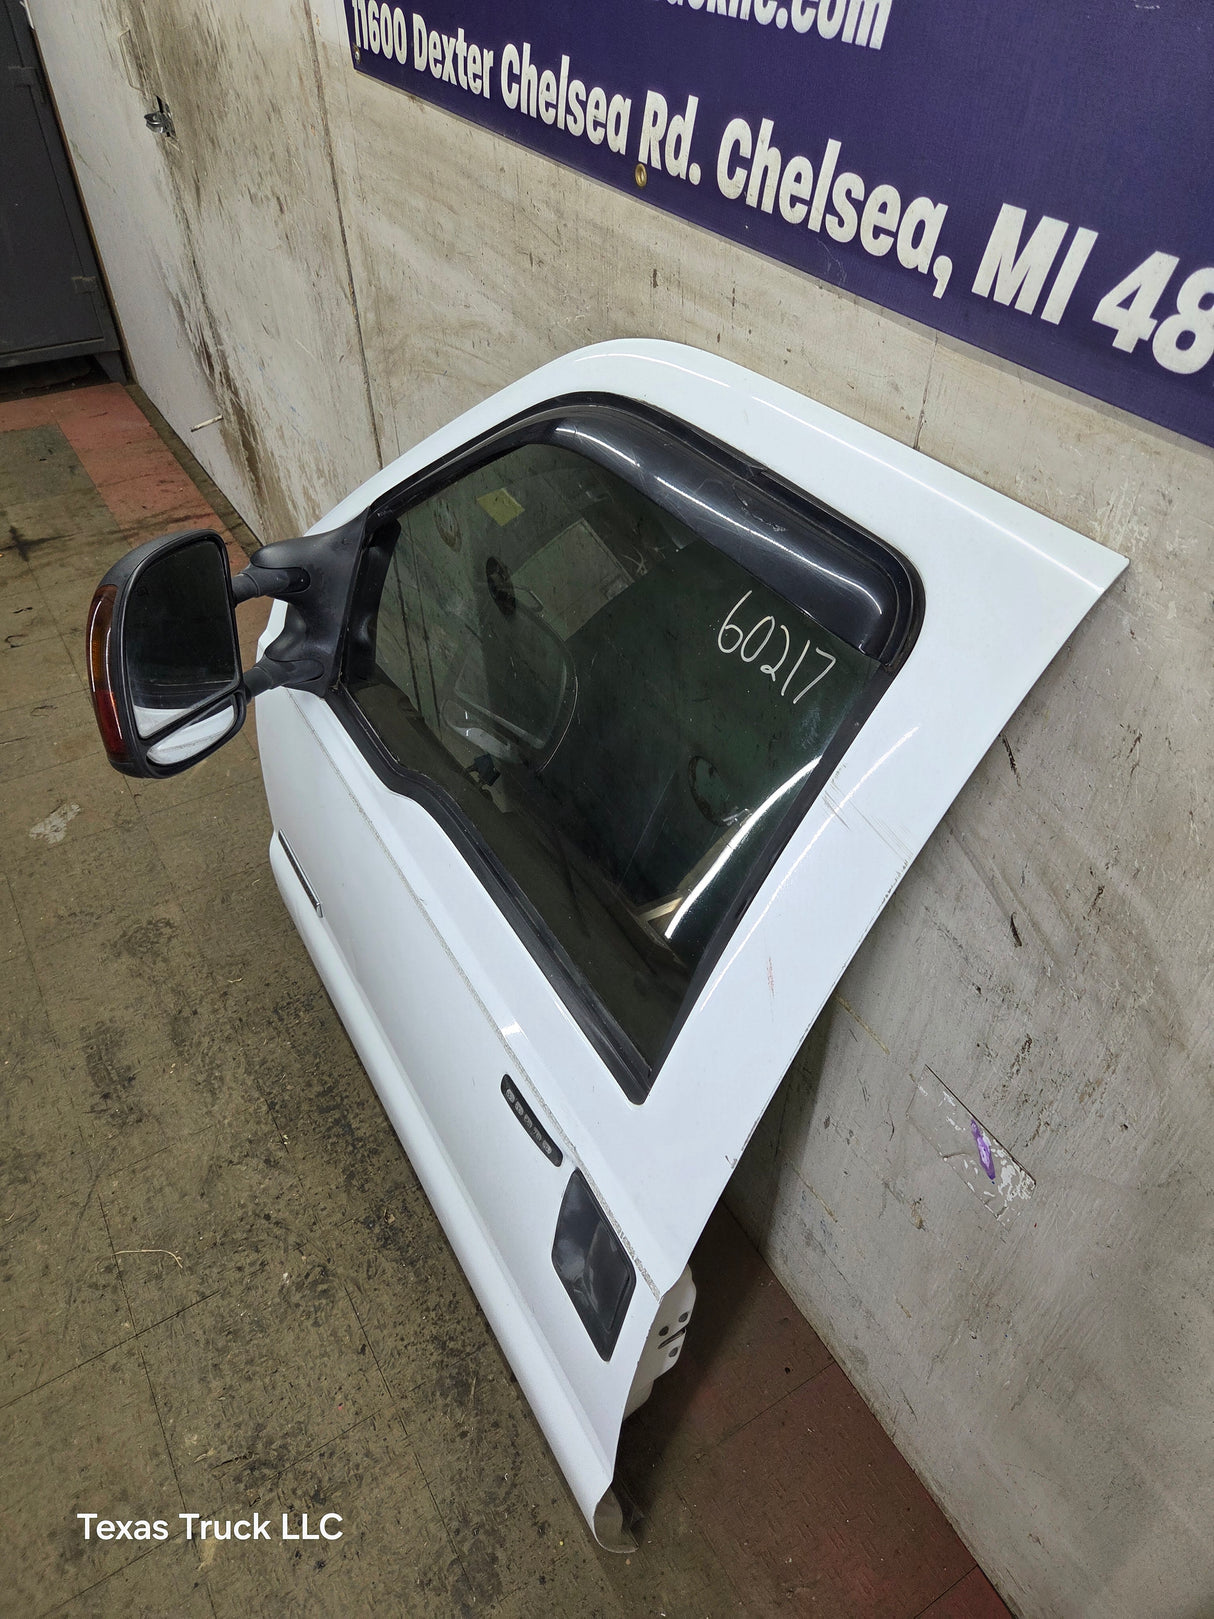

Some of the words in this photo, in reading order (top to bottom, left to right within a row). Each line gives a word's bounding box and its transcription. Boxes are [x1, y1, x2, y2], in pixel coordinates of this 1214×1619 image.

[352, 0, 407, 65] 11600
[412, 13, 494, 99] Dexter
[501, 42, 631, 155] Chelsea
[638, 90, 701, 185] Rd.
[717, 118, 952, 299] Chelsea,
[972, 203, 1098, 325] MI
[717, 589, 837, 705] 60217
